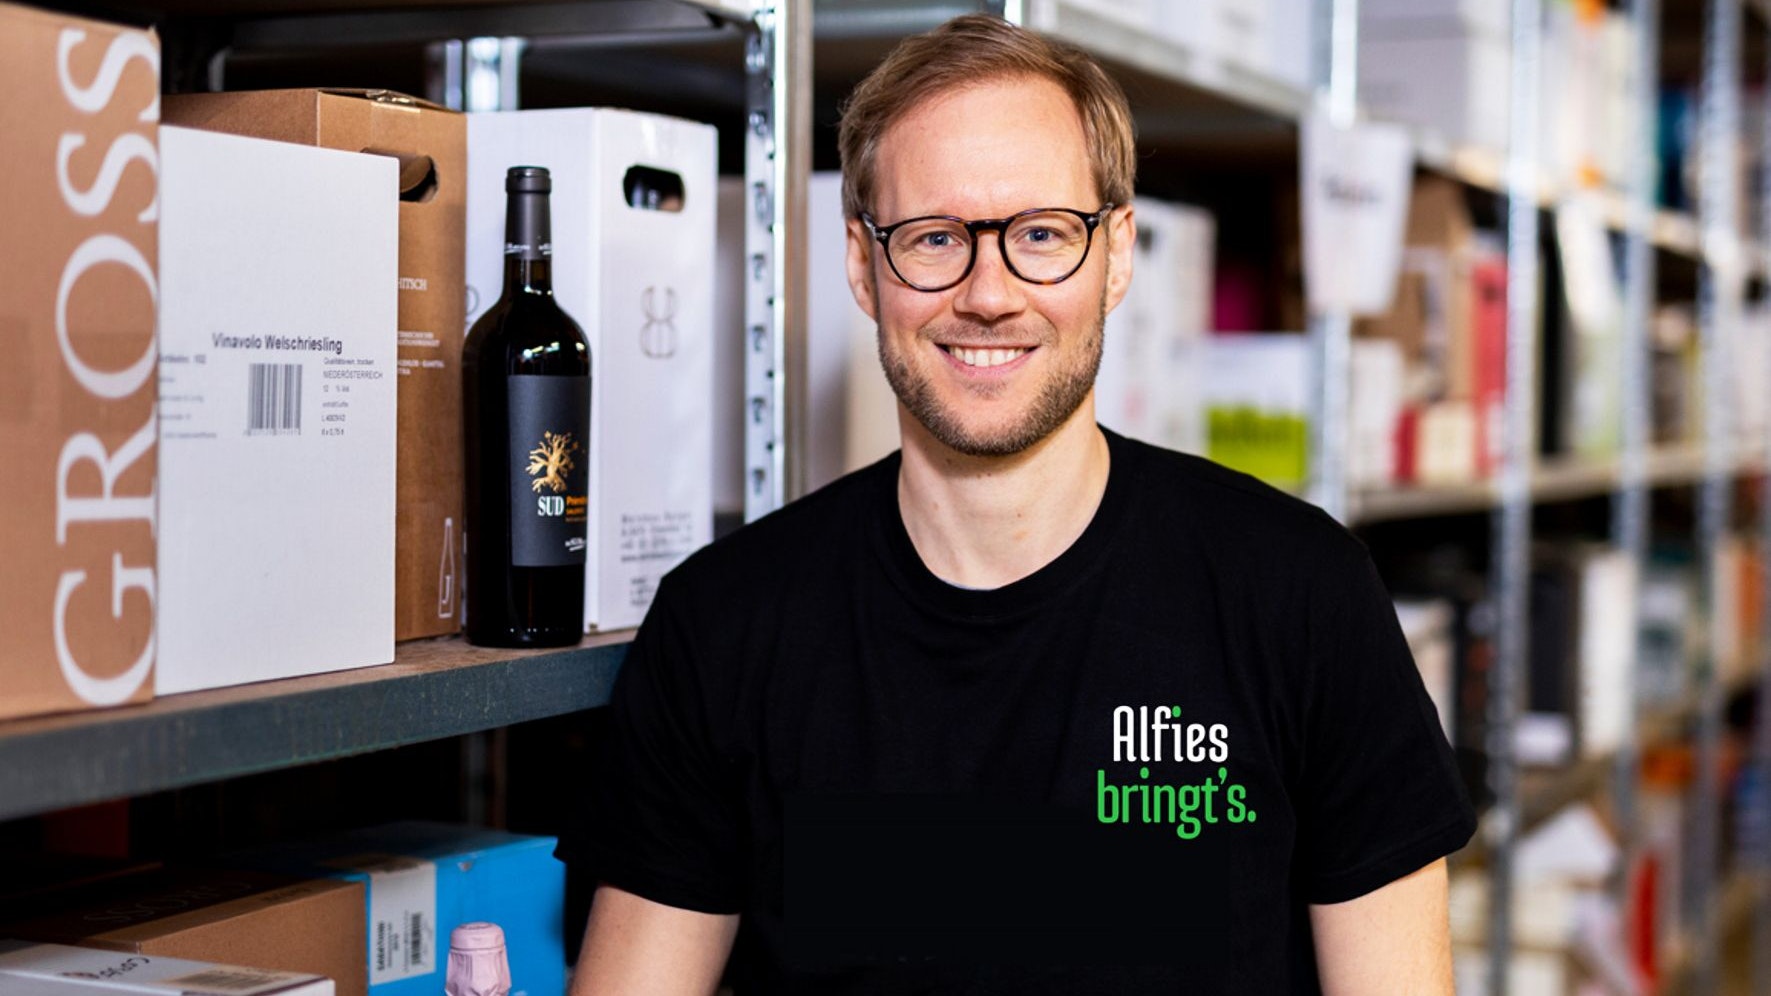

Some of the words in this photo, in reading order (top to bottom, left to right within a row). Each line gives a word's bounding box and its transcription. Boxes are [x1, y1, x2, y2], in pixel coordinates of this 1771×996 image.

[54, 26, 160, 707] GROSS
[212, 332, 262, 349] Vinavolo
[264, 334, 342, 355] Welschriesling
[537, 495, 564, 517] SUD
[1113, 705, 1229, 763] Alfies
[1097, 766, 1257, 840] bringt's.
